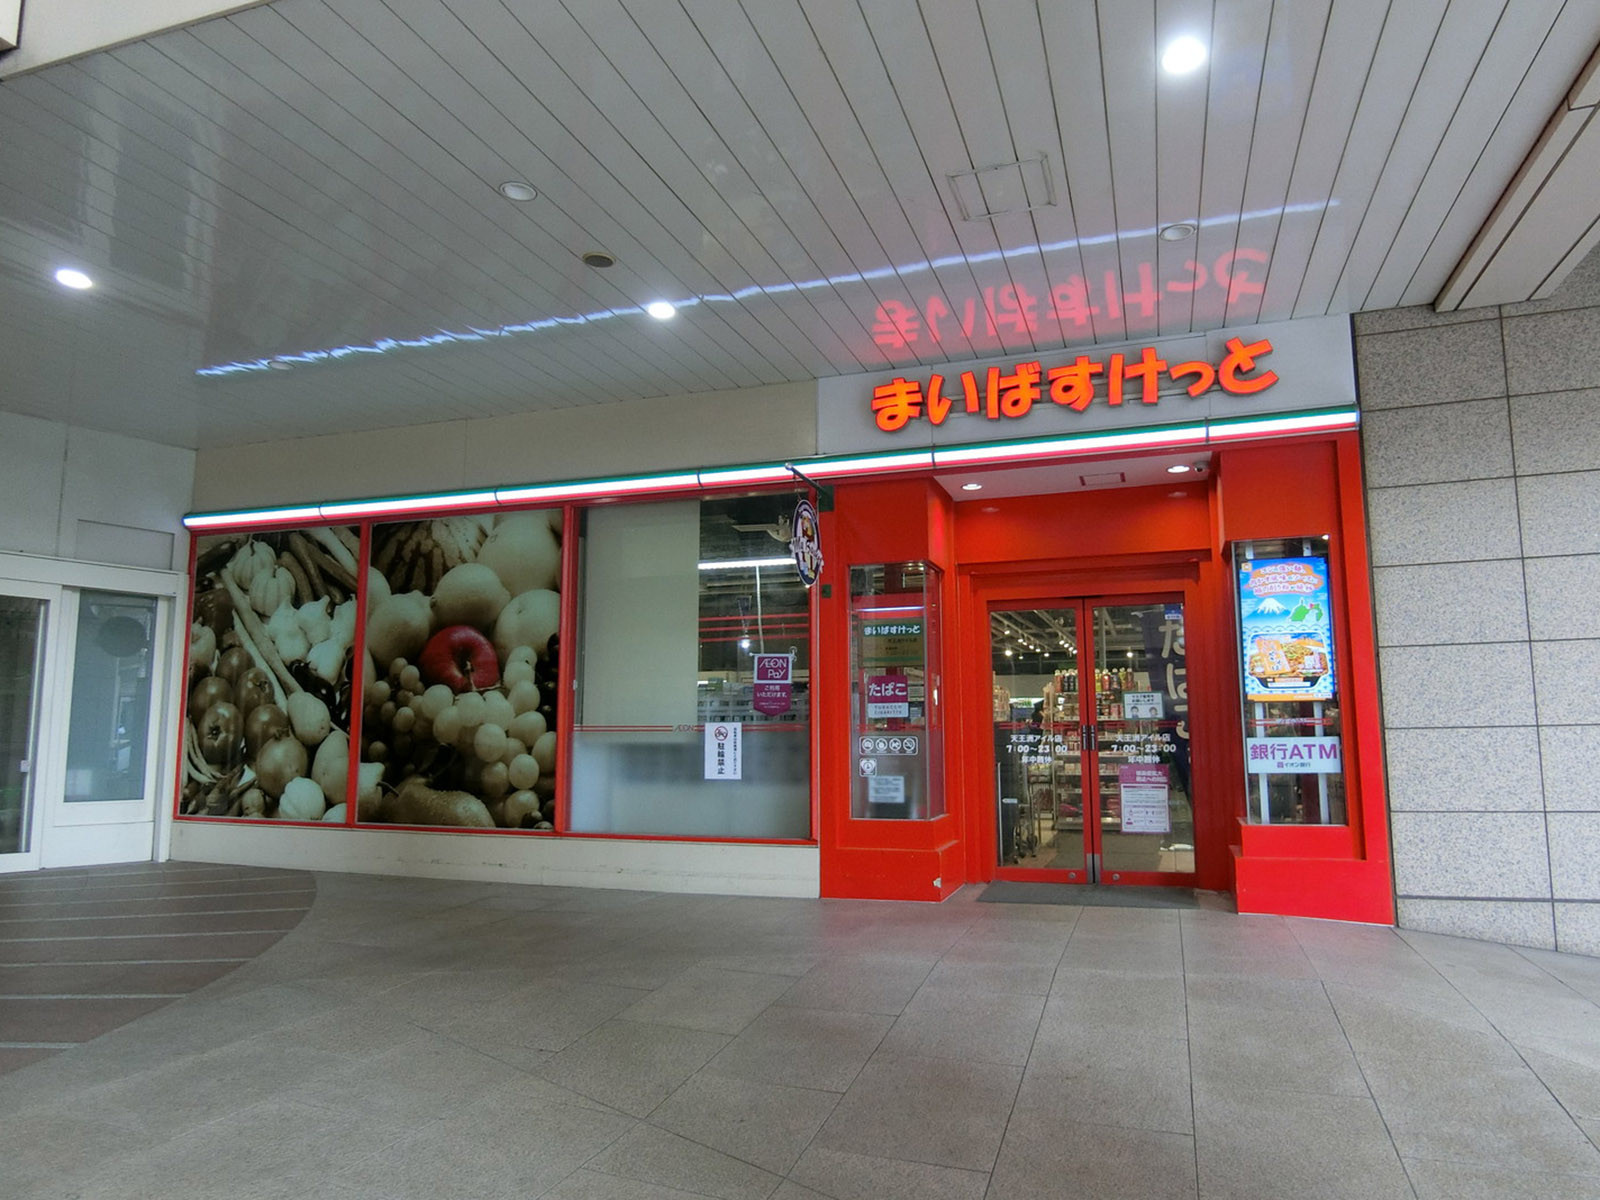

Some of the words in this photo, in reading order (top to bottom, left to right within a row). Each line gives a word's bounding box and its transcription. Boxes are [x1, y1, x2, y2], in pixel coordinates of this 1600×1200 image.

[870, 337, 1279, 432] まいばすけっと
[864, 625, 920, 635] まいばすけっと
[760, 658, 787, 668] AEON
[768, 669, 785, 679] Pay
[869, 683, 907, 696] たばこ
[1250, 743, 1338, 760] 銀行ATM
